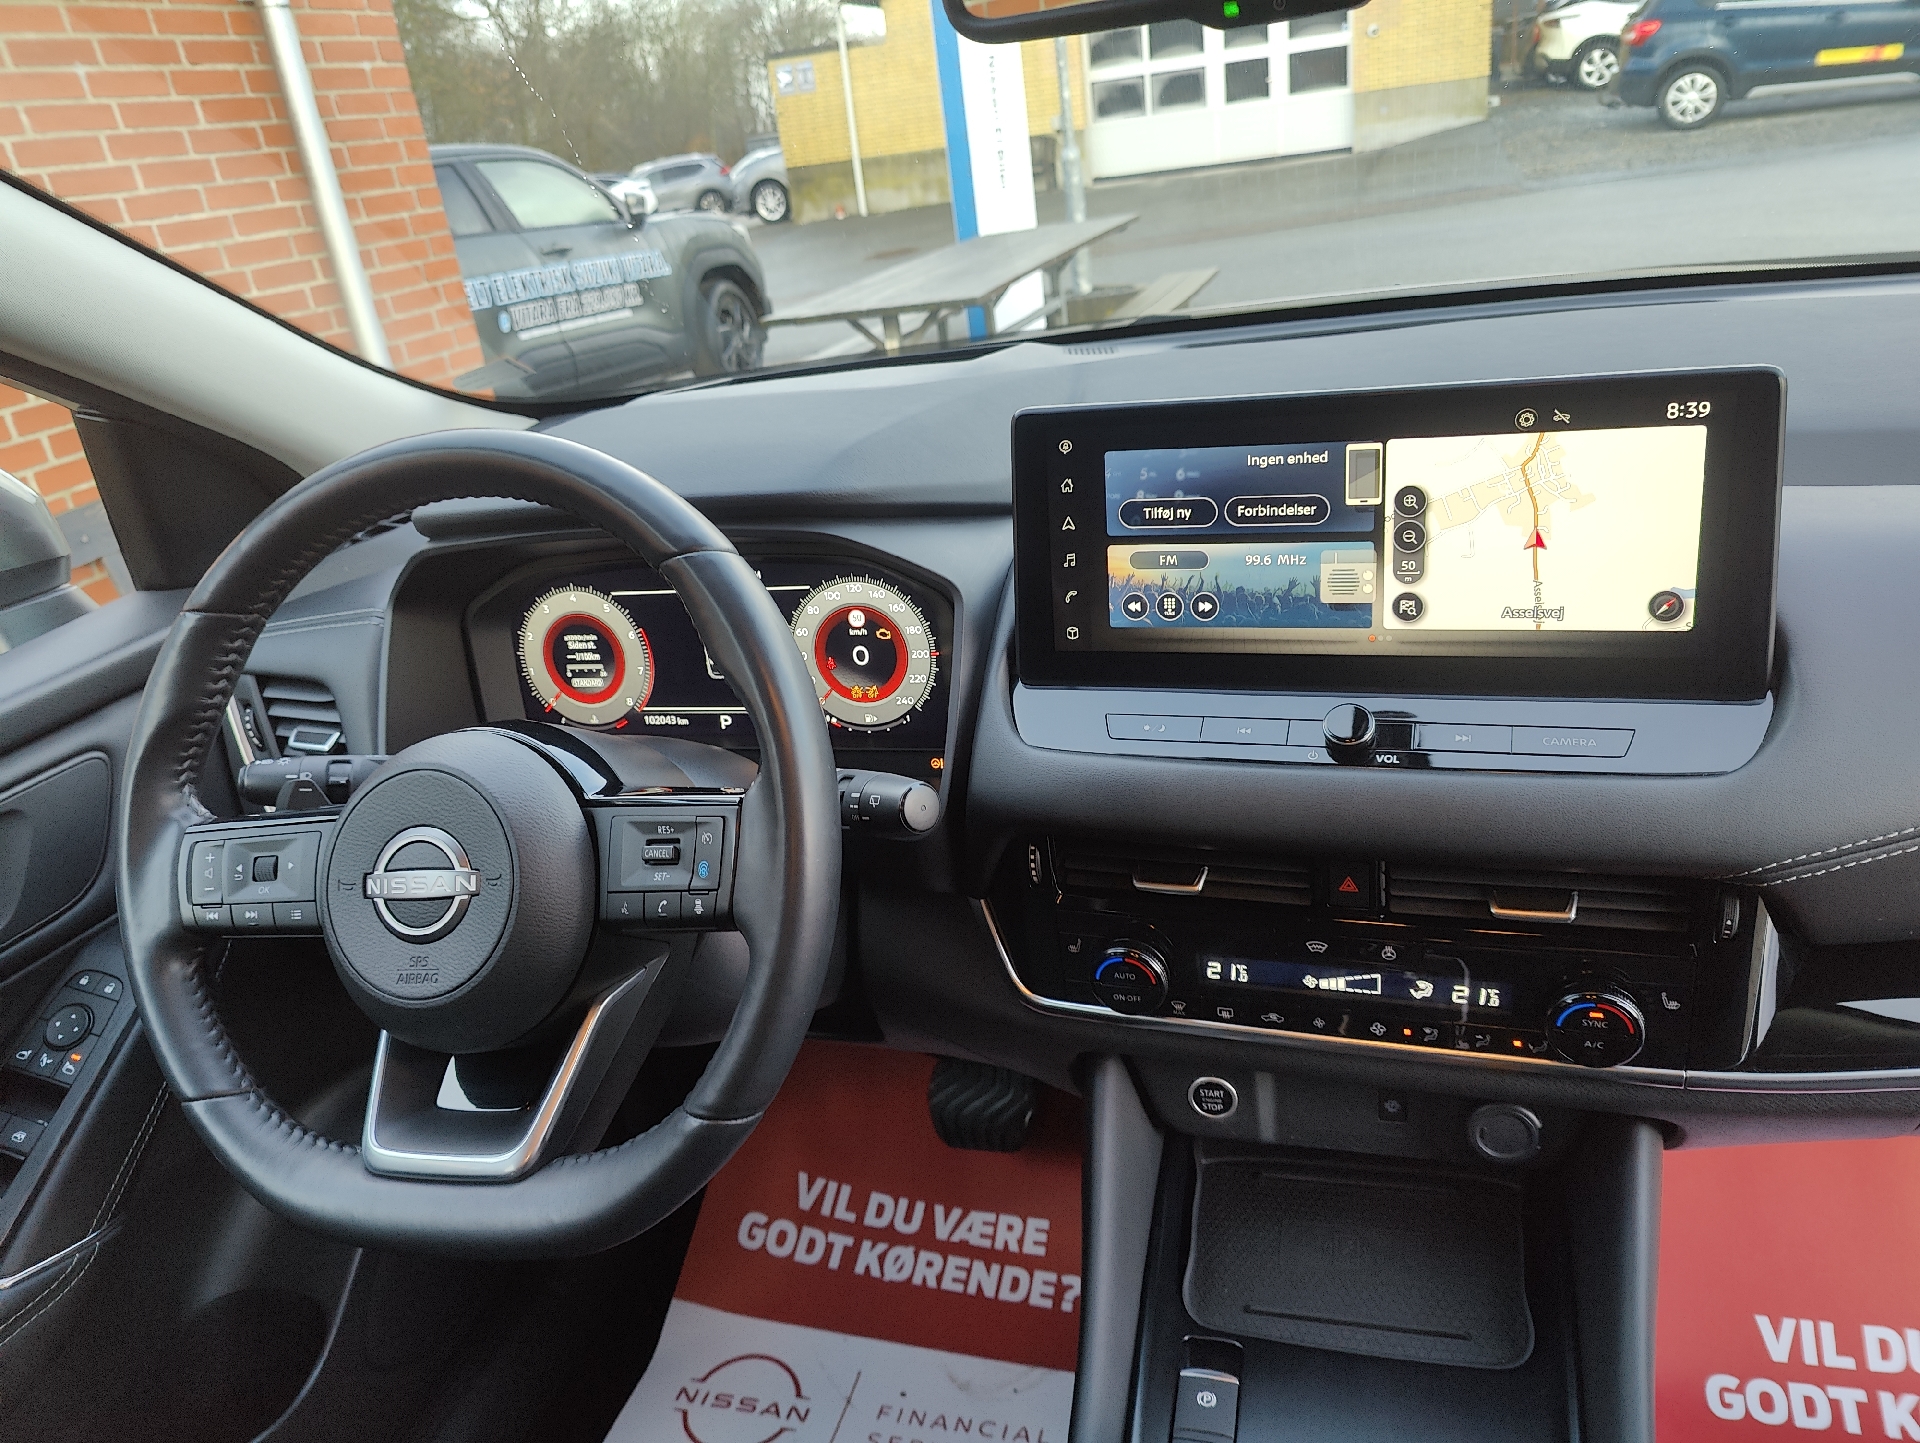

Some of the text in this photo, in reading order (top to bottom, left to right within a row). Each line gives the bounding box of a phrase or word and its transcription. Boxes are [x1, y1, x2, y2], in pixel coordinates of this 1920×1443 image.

[1666, 401, 1711, 420] 8:39
[1246, 451, 1329, 469] Ingen enhed
[1143, 507, 1192, 521] Tilføj ny
[1237, 504, 1317, 518] Forbindelser
[1159, 555, 1178, 566] FM
[1245, 554, 1307, 566] 99.6 MHz
[1401, 560, 1416, 571] 50
[845, 584, 862, 593] 120
[569, 594, 577, 602] 4
[824, 592, 841, 601] 100
[868, 590, 885, 599] 140
[542, 604, 550, 614] 3
[603, 604, 611, 613] 5
[807, 606, 820, 615] 80
[888, 604, 905, 613] 160
[1501, 605, 1565, 621] Asselsvej
[796, 628, 808, 637] 60
[849, 628, 868, 636] km/h
[905, 626, 922, 635] 180
[527, 632, 534, 641] 2
[628, 631, 635, 640] 6
[852, 645, 870, 666] 0
[911, 650, 929, 659] 200
[637, 666, 644, 675] 7
[909, 674, 927, 683] 220
[626, 697, 634, 706] 8
[896, 696, 914, 705] 240
[644, 716, 689, 726] 102043 km
[719, 715, 732, 729] P
[1542, 736, 1597, 747] CAMERA
[1376, 754, 1400, 764] VOL
[657, 825, 675, 834] RES+
[644, 849, 670, 858] CANCEL
[366, 874, 477, 895] NISSAN
[258, 886, 270, 895] OK
[1114, 972, 1136, 980] AUTO
[1581, 1019, 1609, 1029] SYNC
[1584, 1040, 1605, 1049] A/C
[1199, 1088, 1225, 1099] START
[1202, 1102, 1224, 1111] STOP
[797, 1171, 1051, 1257] VIL DU VÆRE
[737, 1211, 1081, 1313] GODT KØRENDE?
[1754, 1313, 1857, 1371] VIL
[675, 1385, 811, 1424] NISSAN
[1705, 1373, 1869, 1436] GODT
[876, 1404, 1050, 1443] FINANCIAL
